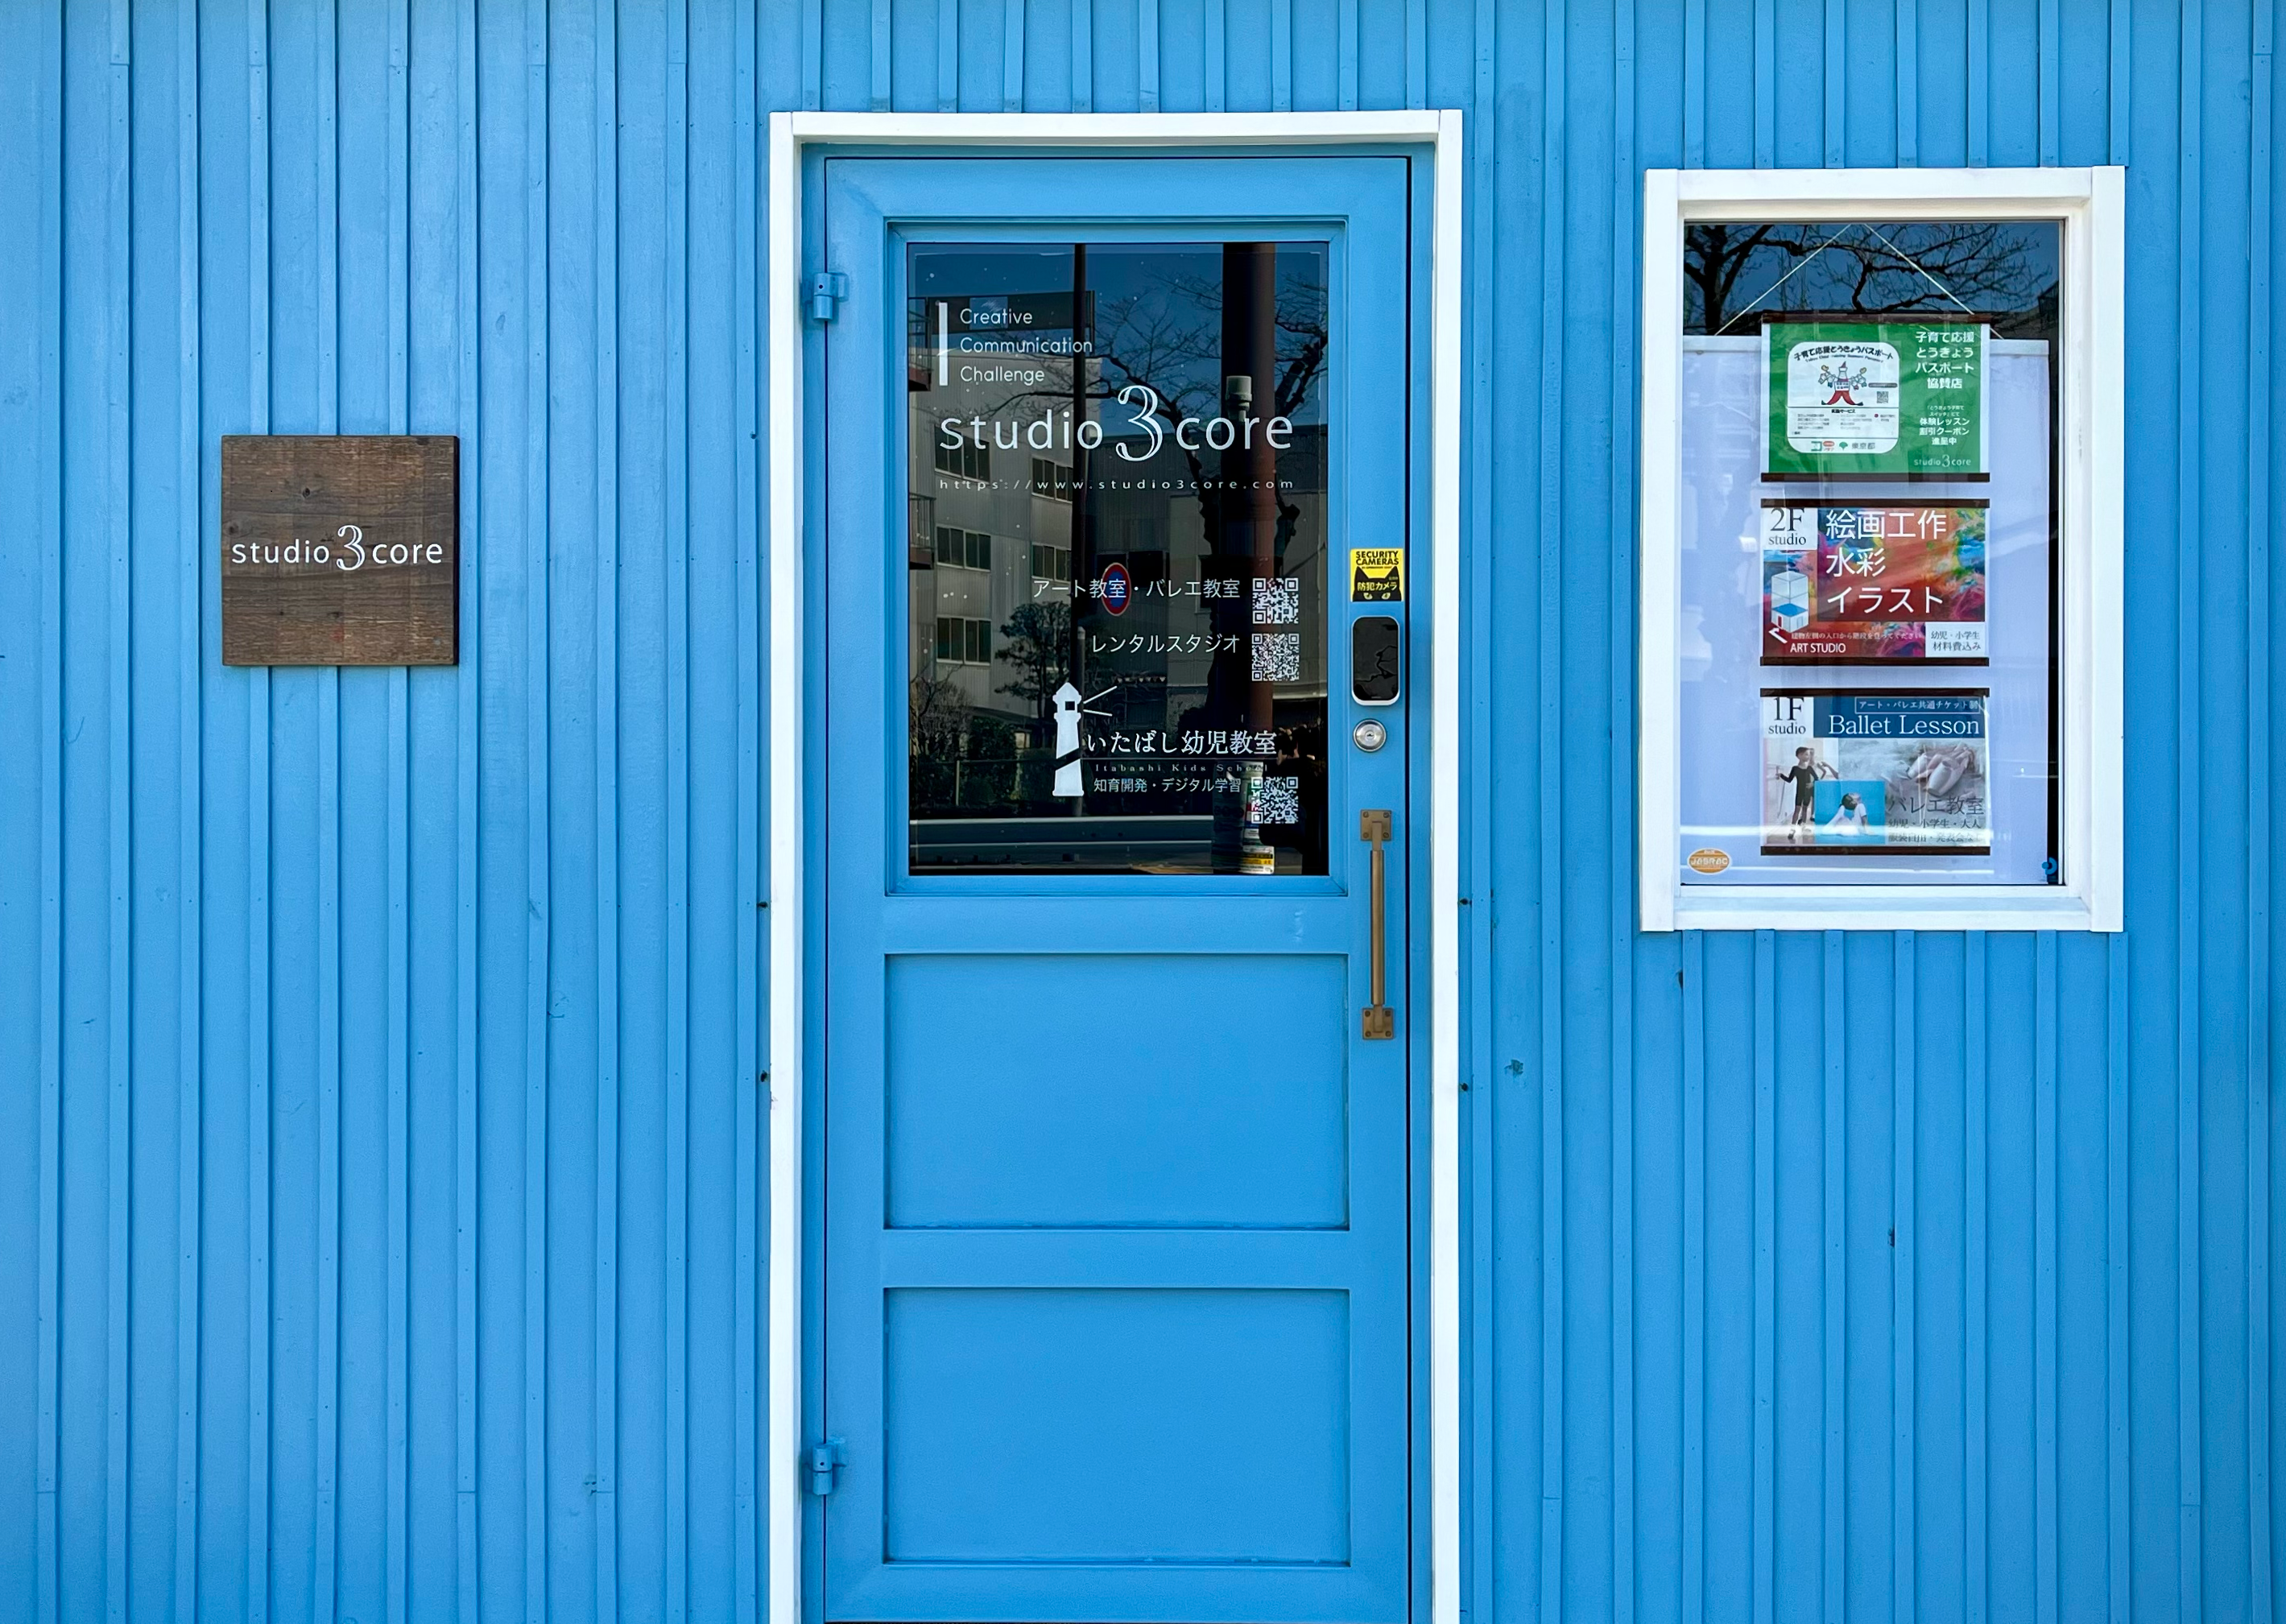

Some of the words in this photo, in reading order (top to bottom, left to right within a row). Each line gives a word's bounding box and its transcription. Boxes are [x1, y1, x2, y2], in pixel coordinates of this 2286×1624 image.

[960, 308, 1033, 324] Creative
[960, 337, 1093, 353] Communication
[1916, 331, 1974, 343] 子育て応援
[1916, 347, 1974, 358] とうきょう
[960, 366, 1045, 386] Challenge
[1916, 362, 1974, 374] パスポート
[1927, 377, 1962, 389] 協賛店
[1920, 417, 1970, 426] 体験レッスン
[1919, 427, 1970, 436] 割引クーポン
[940, 478, 1294, 492] https://www.studio3core.com
[1770, 507, 1805, 531] 2F
[1826, 509, 1947, 539] 絵画工作
[1768, 532, 1807, 545] studio
[1826, 547, 1886, 577] 水彩
[1033, 578, 1241, 598] アート教室・バレエ教室
[1357, 581, 1398, 591] 防犯カメラ
[1827, 586, 1943, 614] イラスト
[1092, 633, 1240, 654] レンタルスタジオ
[1790, 643, 1809, 653] ART
[1810, 643, 1846, 653] STUDIO
[1933, 641, 1982, 651] 材料費込み
[1773, 696, 1804, 721] 1F
[1768, 722, 1806, 734] studio
[1829, 714, 1892, 735] Ballet
[1899, 714, 1979, 735] Lesson
[1087, 729, 1277, 755] いたばし幼児教室
[1095, 763, 1162, 772] Itabashi
[1172, 763, 1206, 772] Kids
[1093, 777, 1242, 793] 知育開発・デジタル学習
[1887, 795, 1984, 815] バレエ教室
